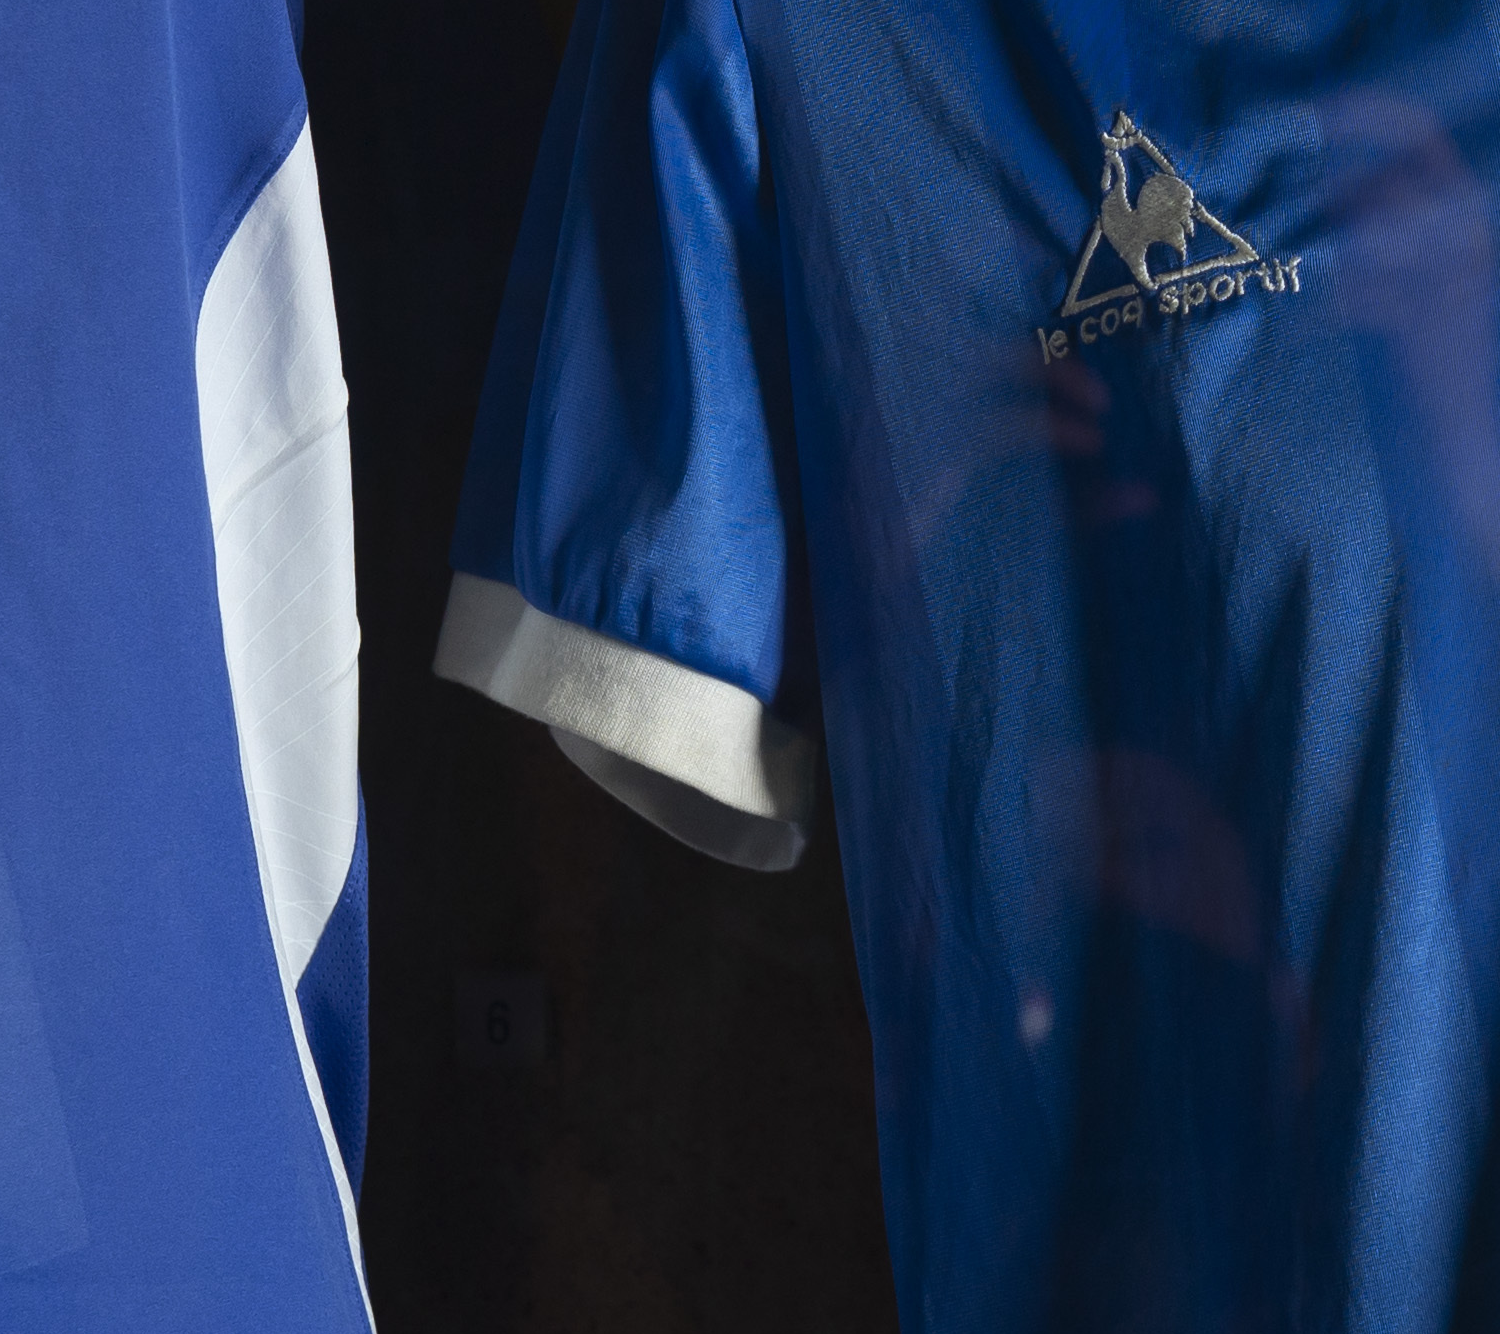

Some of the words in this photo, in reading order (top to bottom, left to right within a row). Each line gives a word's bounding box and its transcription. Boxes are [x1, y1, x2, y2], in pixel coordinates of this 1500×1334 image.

[1037, 327, 1069, 365] le
[1080, 297, 1144, 345] coq
[1158, 256, 1302, 315] sportif
